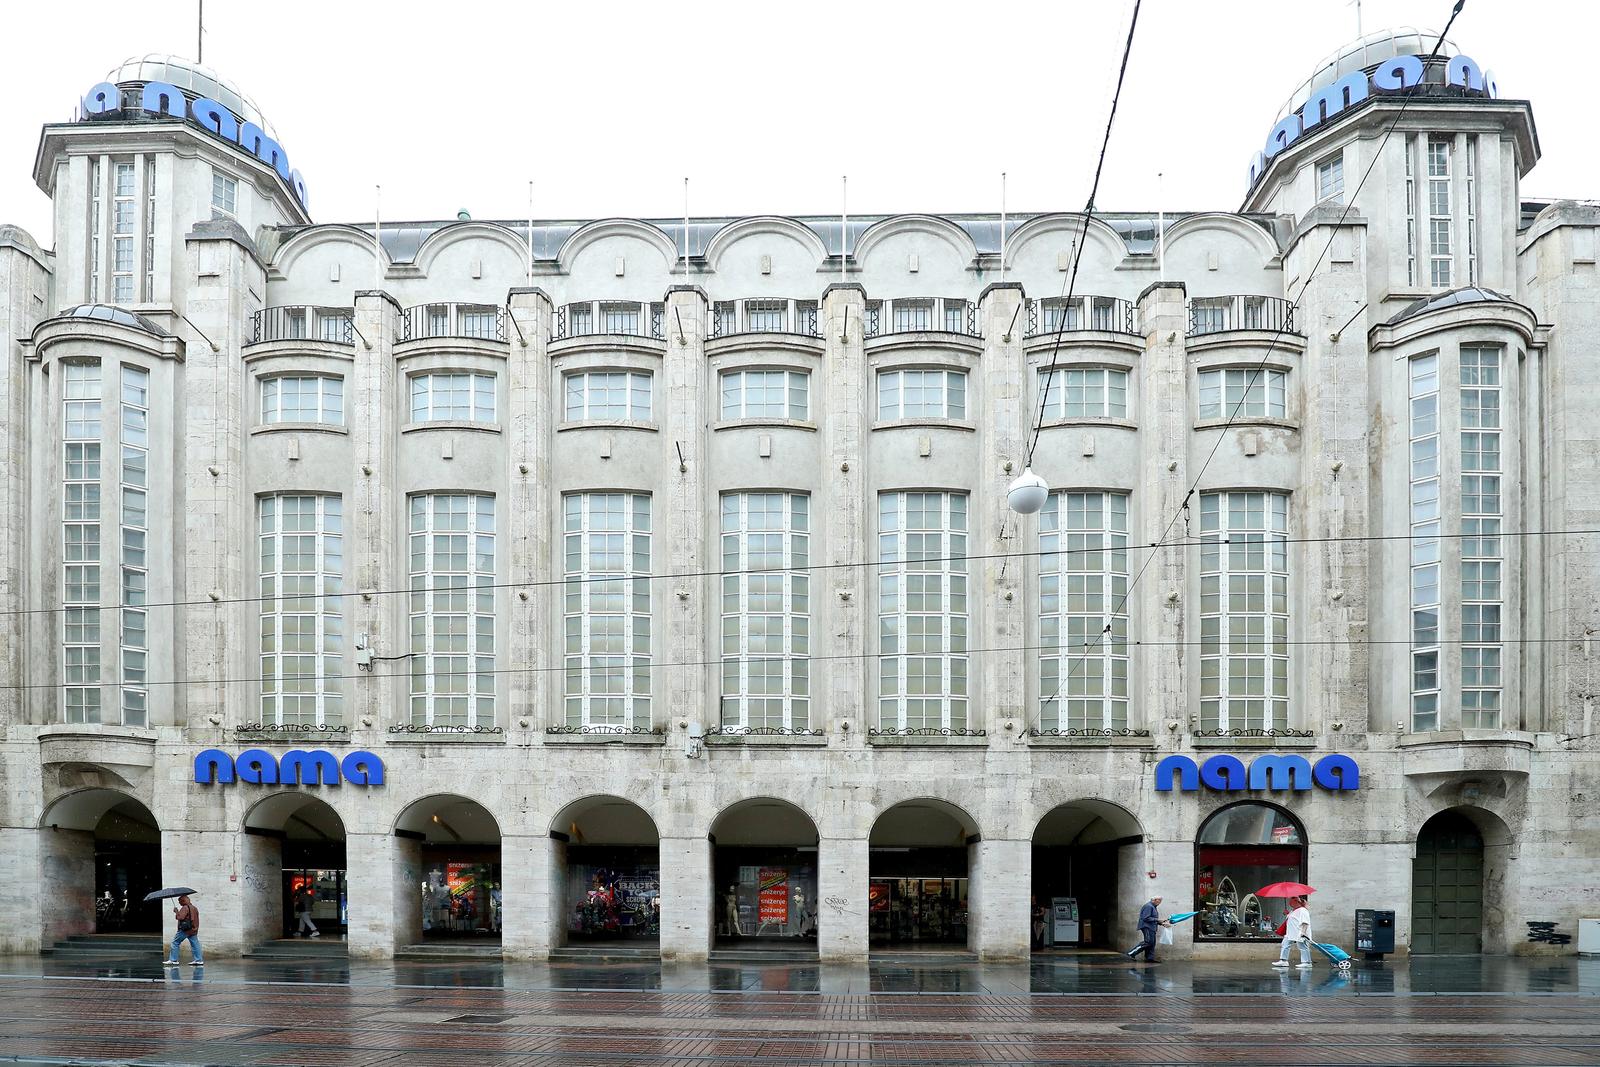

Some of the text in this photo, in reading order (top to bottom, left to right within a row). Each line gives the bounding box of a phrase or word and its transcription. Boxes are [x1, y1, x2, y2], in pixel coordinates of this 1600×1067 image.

[194, 749, 384, 785] nama
[1155, 754, 1360, 791] nama
[619, 882, 654, 890] BACK
